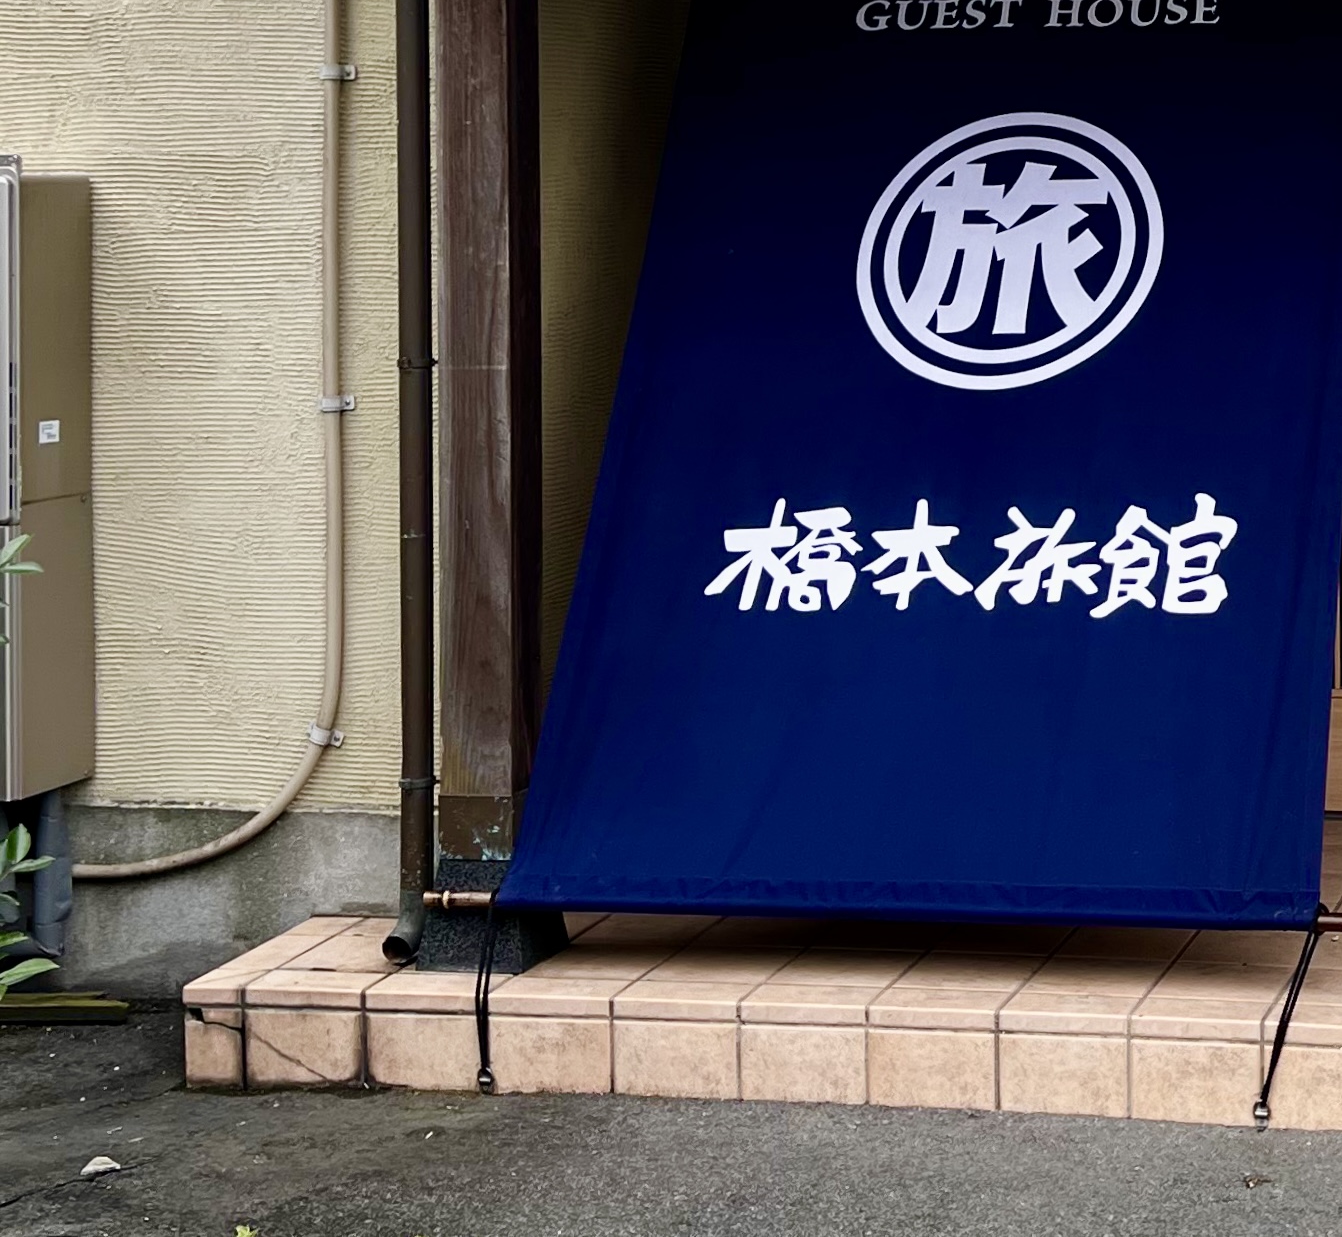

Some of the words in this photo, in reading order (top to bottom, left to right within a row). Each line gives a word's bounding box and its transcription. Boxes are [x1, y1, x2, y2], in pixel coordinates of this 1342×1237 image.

[904, 161, 1110, 336] 旅
[703, 492, 1238, 619] 橋本旅館
